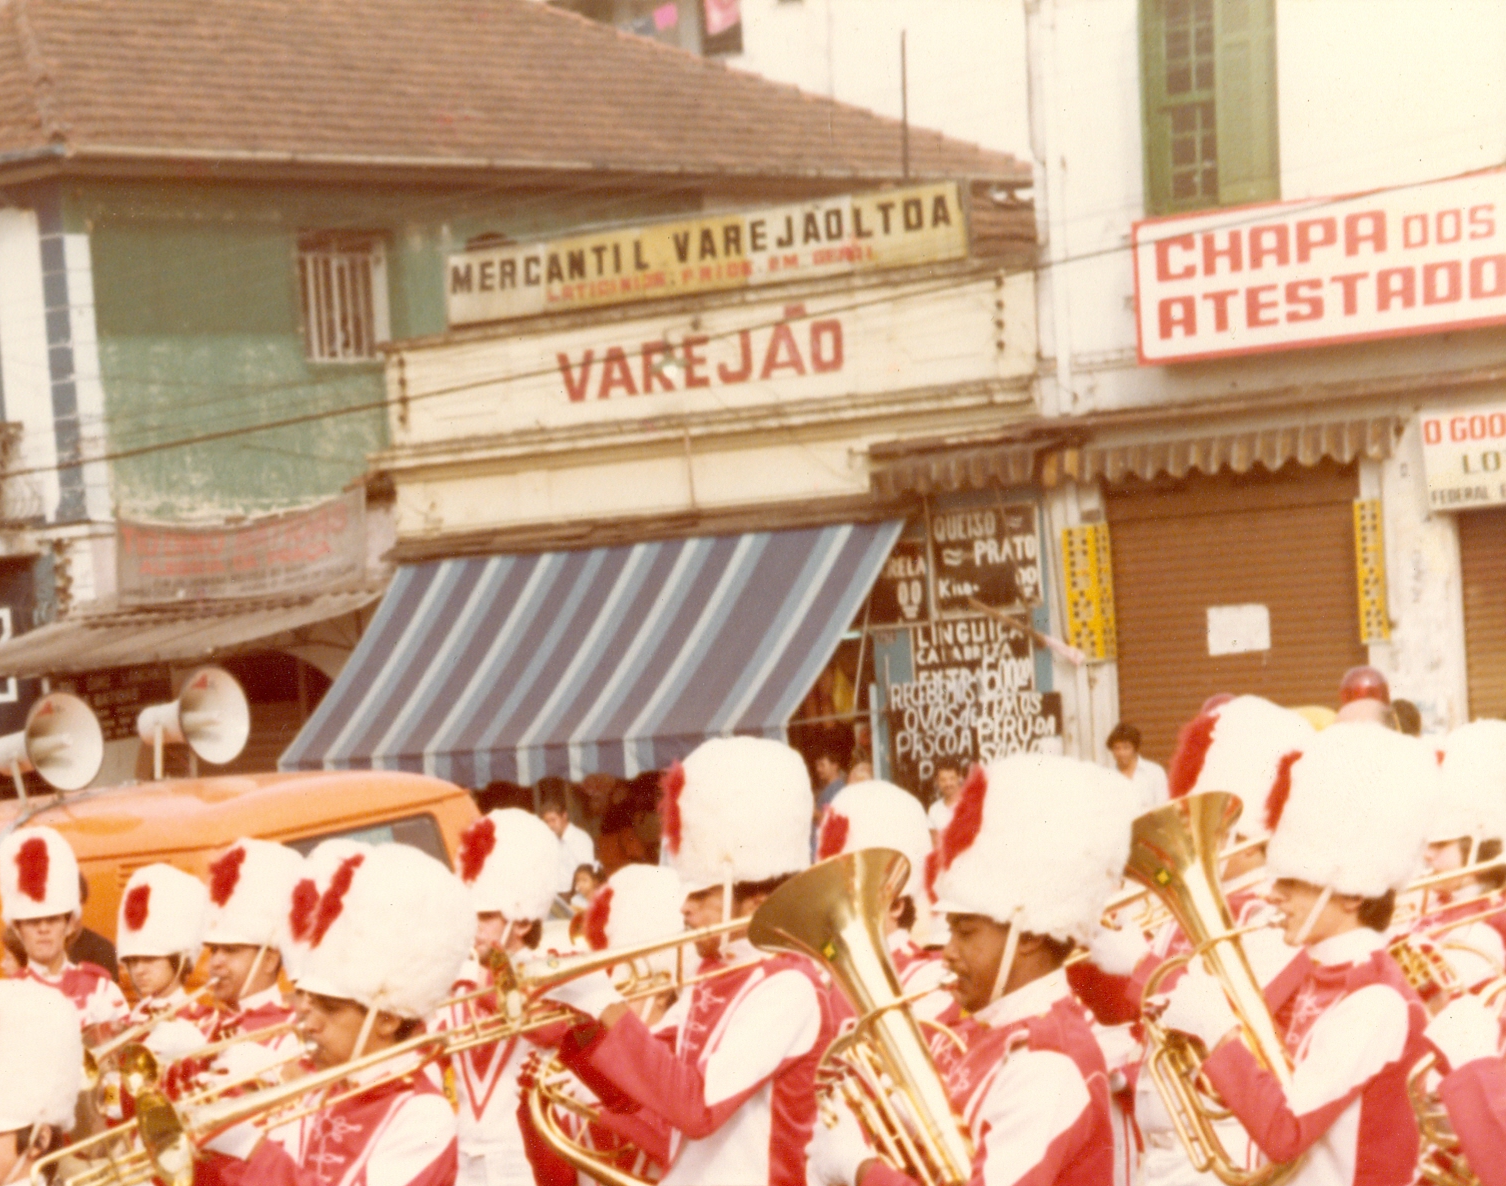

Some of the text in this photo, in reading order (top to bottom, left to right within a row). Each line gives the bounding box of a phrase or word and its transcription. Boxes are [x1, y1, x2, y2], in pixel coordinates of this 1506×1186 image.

[450, 239, 649, 294] MERCANTIL
[1155, 203, 1495, 283] CHAPA DOS
[1158, 253, 1506, 340] ATESTADO
[556, 303, 843, 402] VAREJÃO
[973, 534, 1037, 567] PRATO
[904, 702, 956, 733] OVOS
